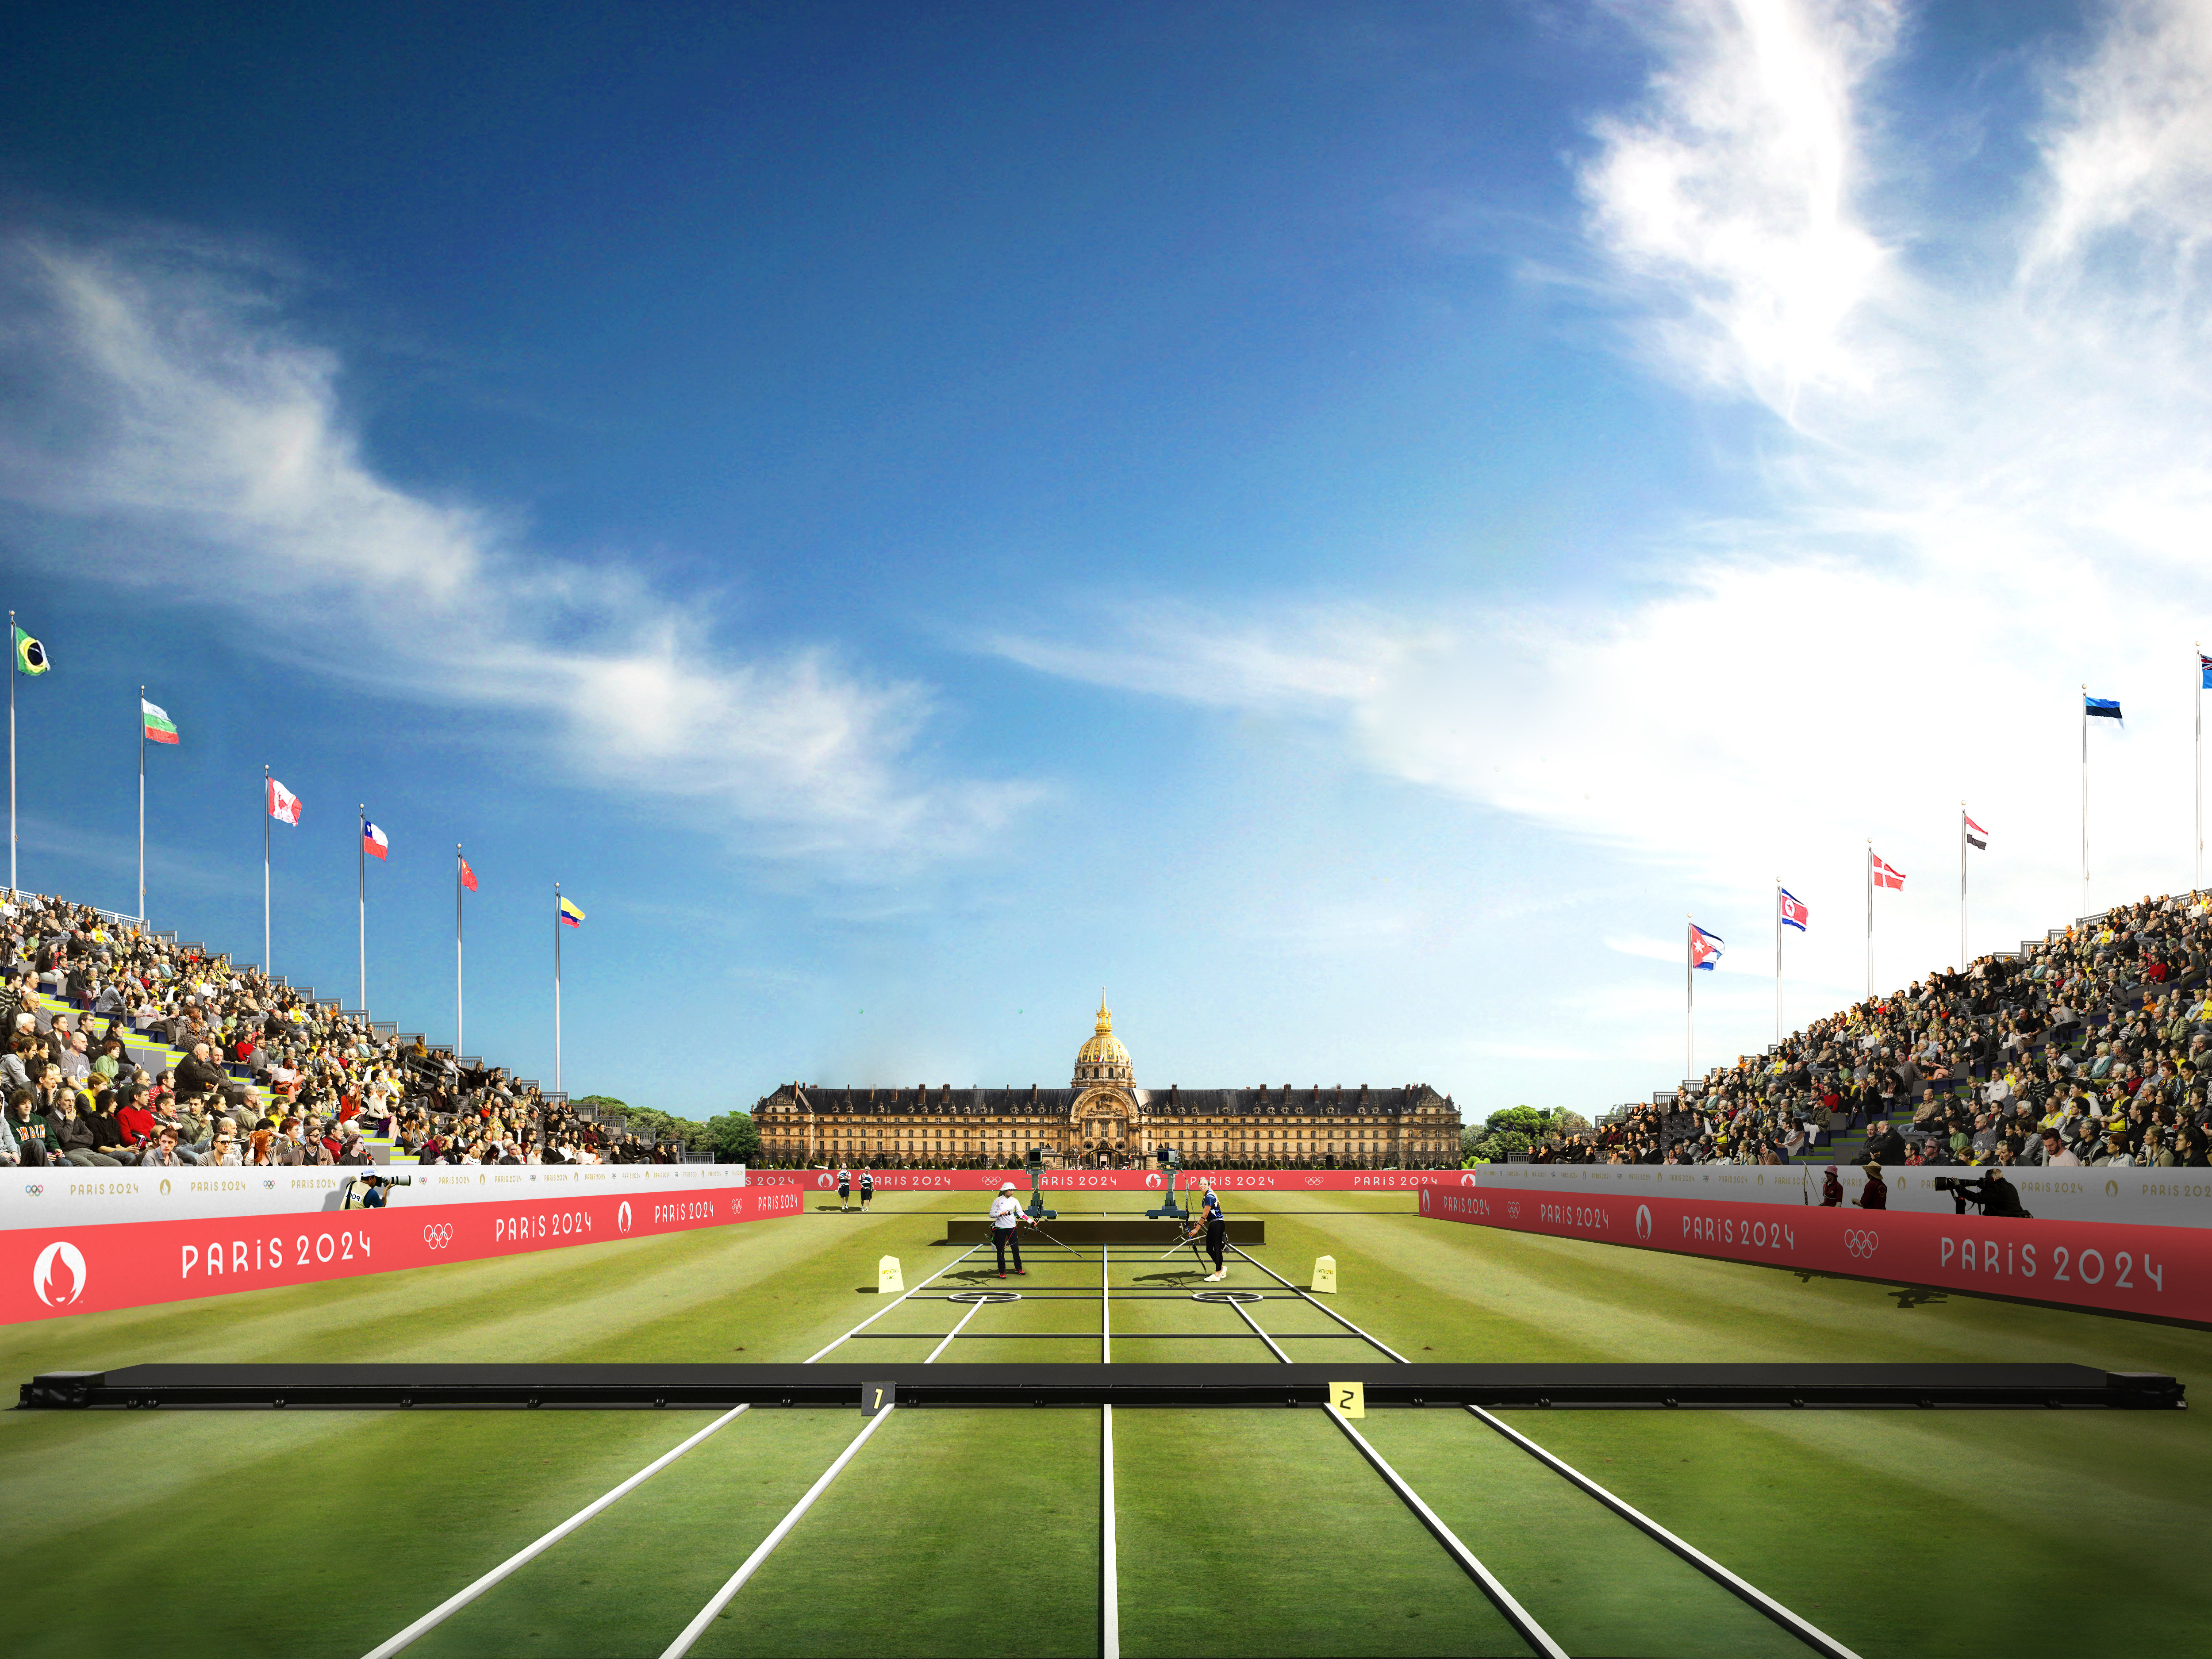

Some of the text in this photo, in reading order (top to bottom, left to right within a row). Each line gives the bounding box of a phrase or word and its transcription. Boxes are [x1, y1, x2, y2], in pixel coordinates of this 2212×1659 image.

[222, 1181, 245, 1190] 2024
[317, 1179, 335, 1188] 2024
[758, 1177, 794, 1185] 2024
[913, 1176, 950, 1185] 2024
[1237, 1177, 1274, 1185] 2024
[1401, 1177, 1436, 1185] 2024
[109, 1183, 138, 1194] 2024
[2055, 1183, 2082, 1193] 2024
[2185, 1186, 2211, 1197] 202
[781, 1194, 797, 1208] 2024
[1468, 1198, 1489, 1215] 2024
[689, 1201, 713, 1219] 2024
[553, 1212, 591, 1235] 2024
[1577, 1207, 1608, 1229] 2024
[1741, 1221, 1793, 1249] 2024
[297, 1231, 370, 1265] 2024
[2054, 1246, 2162, 1291] 2024
[874, 1388, 883, 1409] 1
[1340, 1390, 1354, 1410] 2
